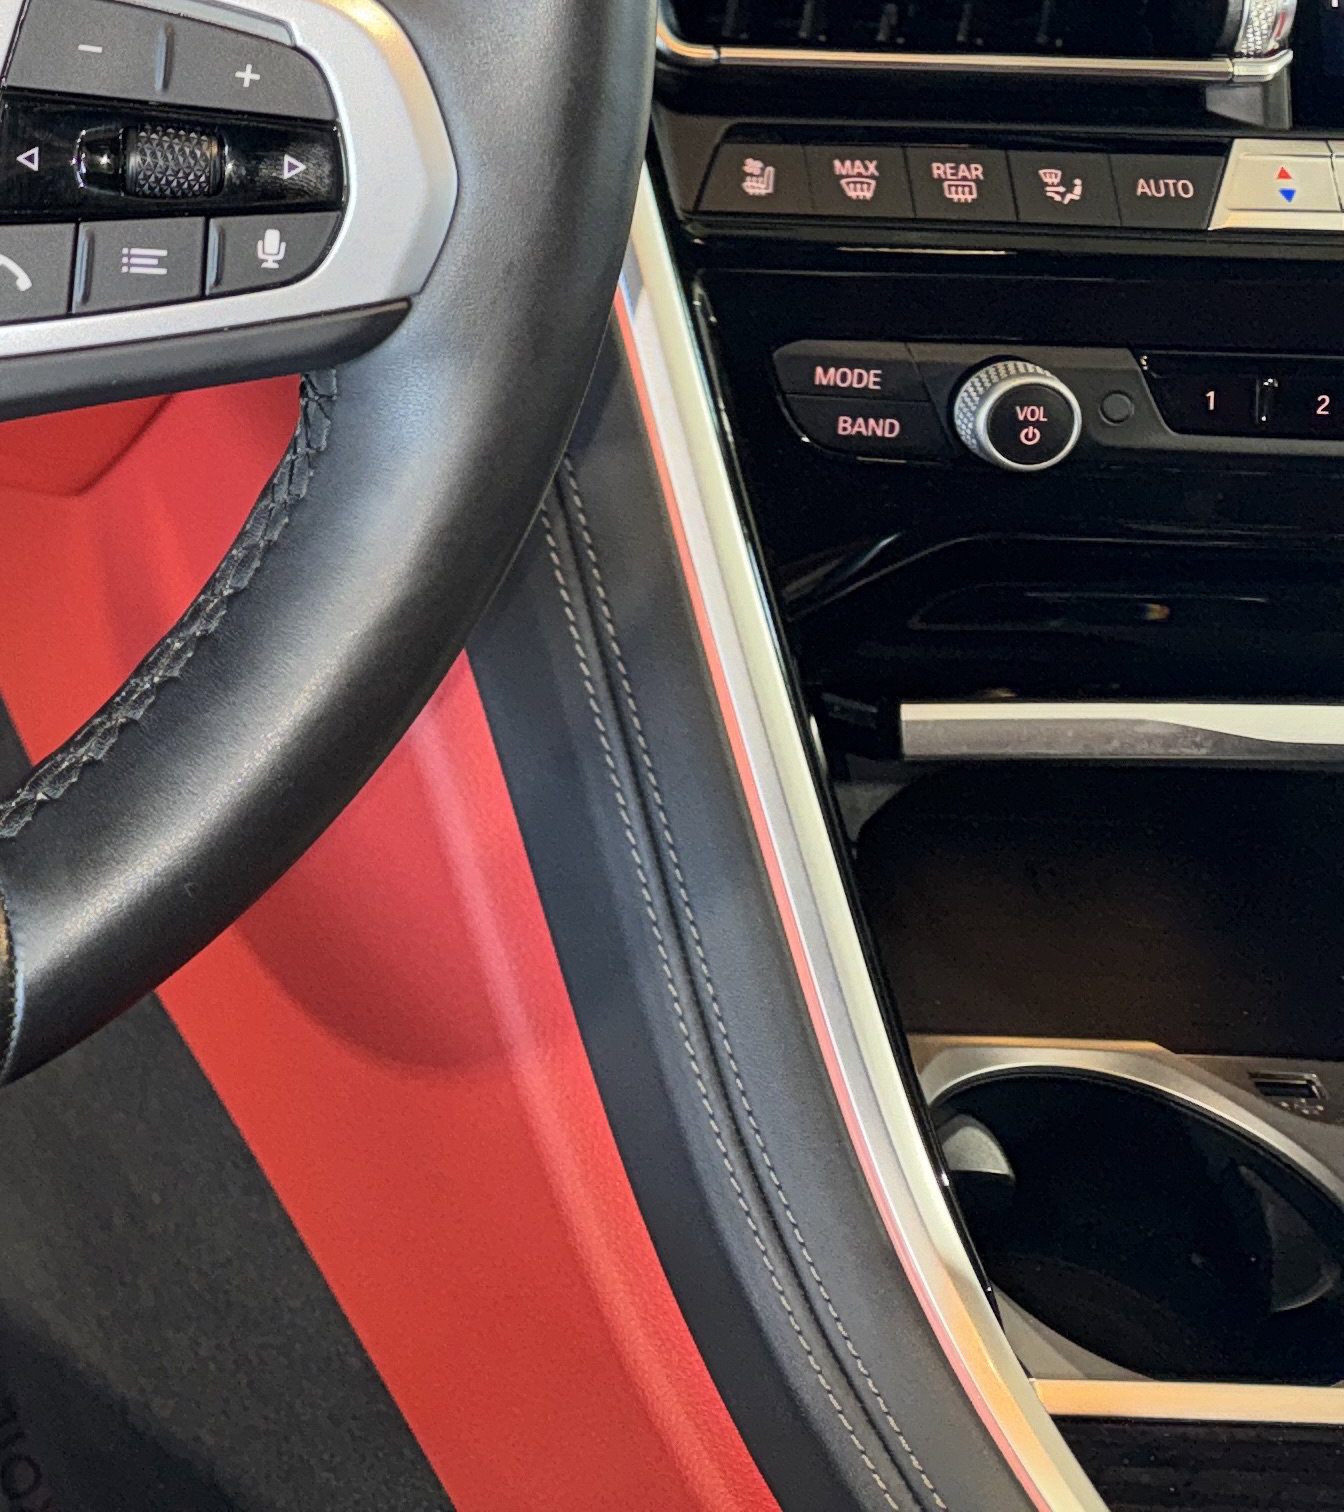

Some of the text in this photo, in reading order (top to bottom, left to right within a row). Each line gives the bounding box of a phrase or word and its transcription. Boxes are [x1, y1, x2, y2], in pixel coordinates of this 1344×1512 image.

[833, 158, 879, 179] MAX
[931, 162, 984, 181] REAR
[1135, 178, 1194, 200] AUTO
[814, 366, 883, 390] MODE
[1205, 390, 1215, 411] 1
[1316, 394, 1330, 416] 2
[1015, 404, 1048, 424] VOL
[837, 415, 900, 439] BAND
